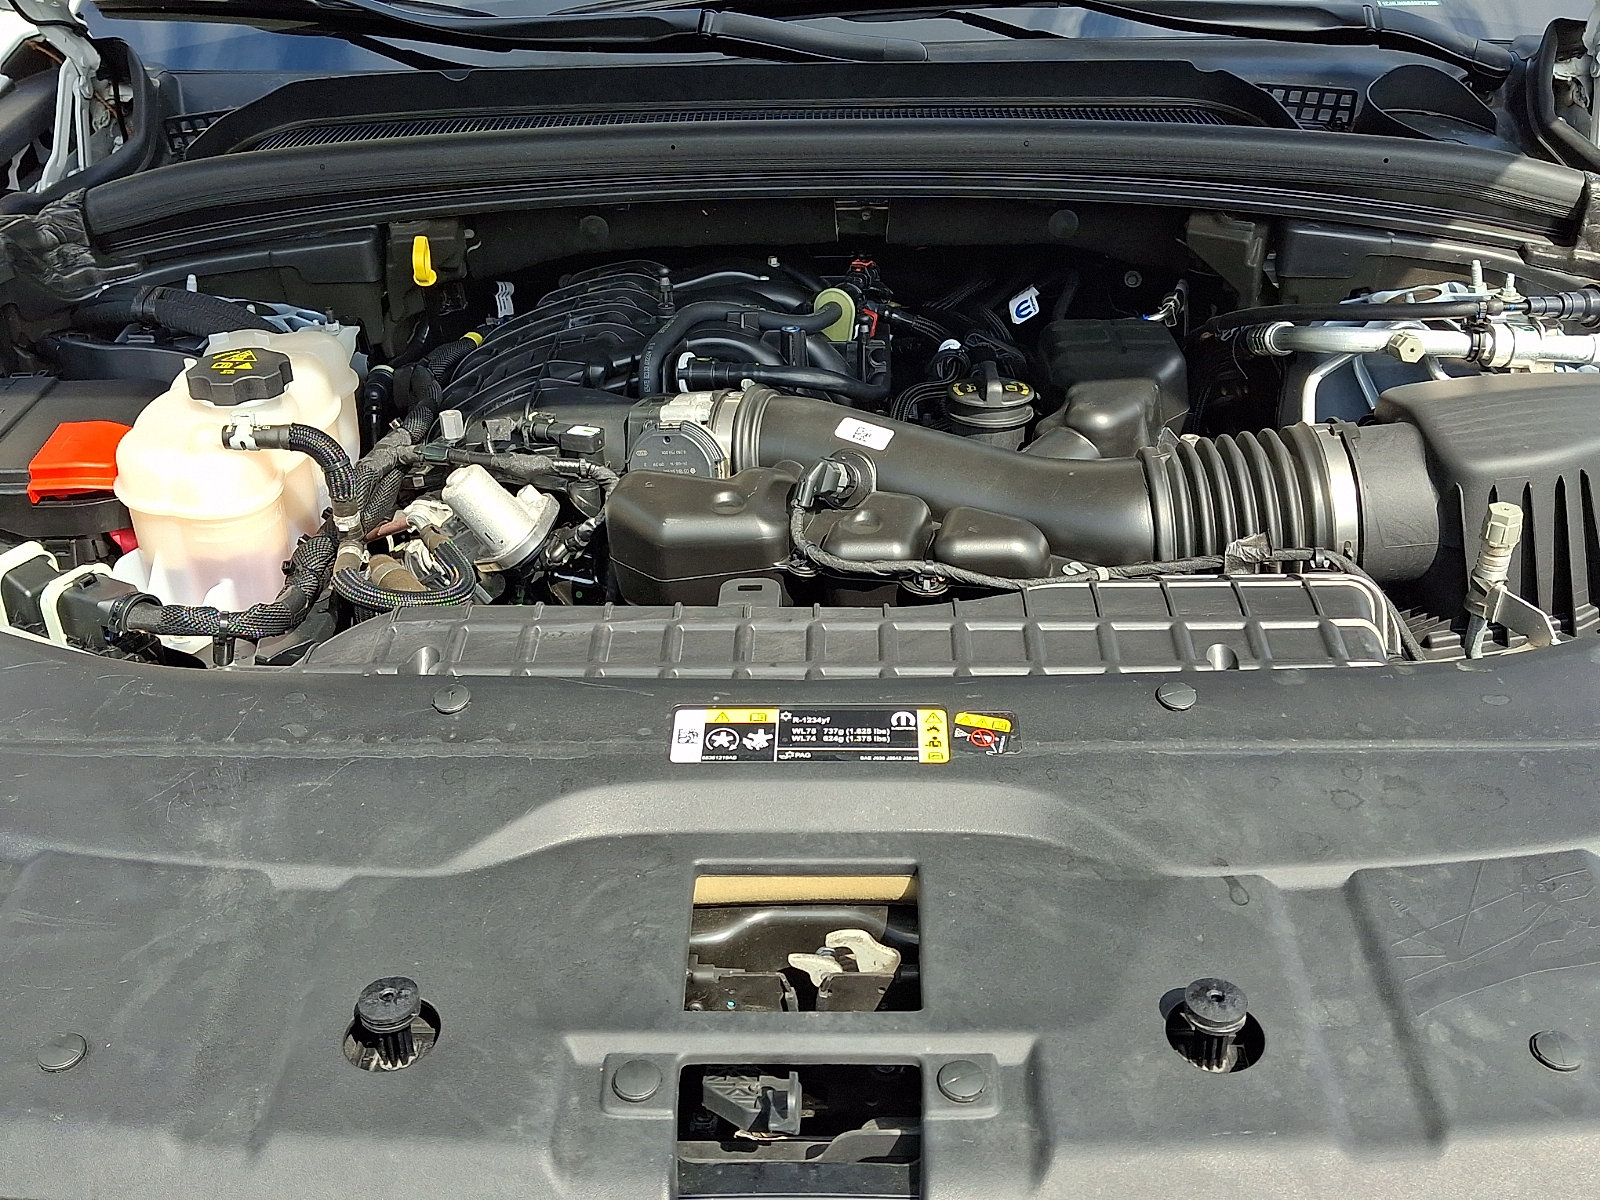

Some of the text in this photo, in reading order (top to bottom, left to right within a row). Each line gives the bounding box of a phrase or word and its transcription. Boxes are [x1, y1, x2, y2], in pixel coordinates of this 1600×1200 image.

[792, 716, 831, 725] R-1234yf
[823, 727, 844, 736] 737g
[873, 727, 891, 736] lbs)
[873, 735, 891, 743] lbs)
